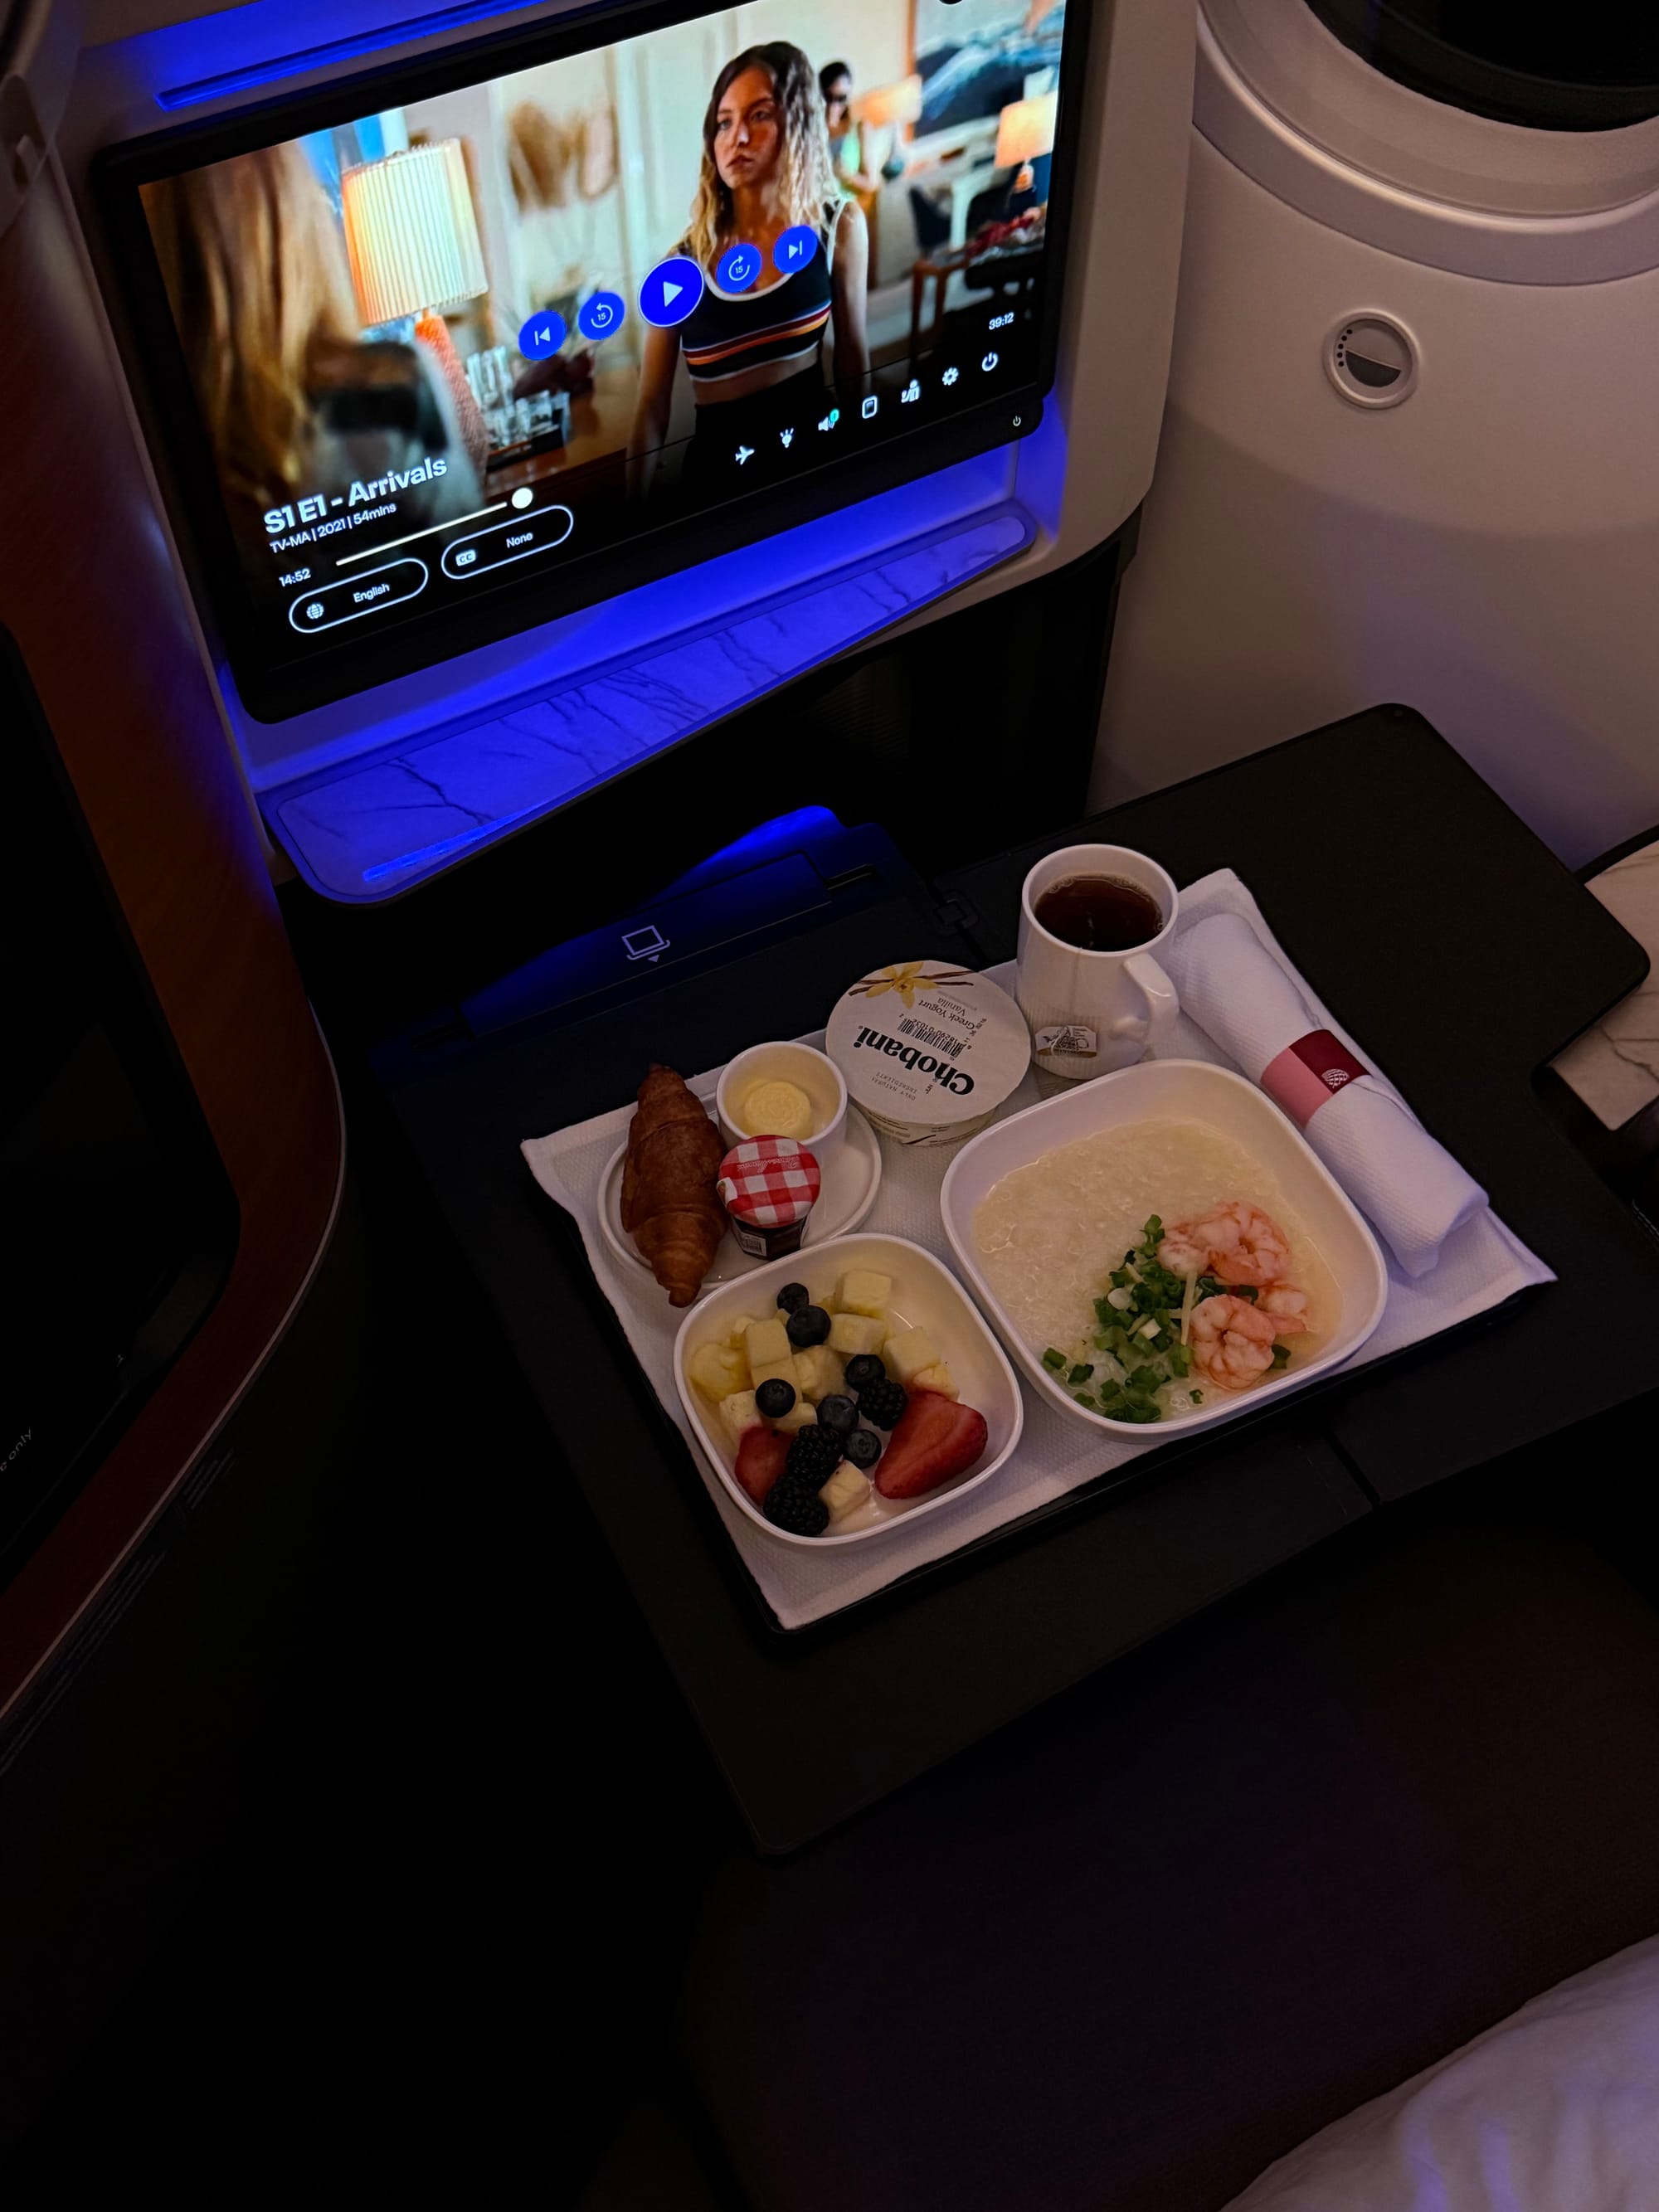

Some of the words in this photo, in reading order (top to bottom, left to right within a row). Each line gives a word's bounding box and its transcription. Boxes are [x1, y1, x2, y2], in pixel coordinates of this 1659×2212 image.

[735, 265, 744, 275] 15
[597, 312, 607, 322] 15
[988, 312, 1015, 330] 39:12
[263, 503, 295, 534] S1
[298, 493, 328, 524] E1
[330, 496, 344, 507] -
[347, 457, 447, 505] Arrivals
[270, 531, 311, 554] TV-MA
[317, 518, 346, 538] 2021
[353, 503, 397, 525] 54mins
[505, 531, 534, 548] None
[278, 567, 312, 587] 14:52
[353, 582, 391, 603] English
[917, 999, 949, 1018] Yogurt
[937, 997, 966, 1016] Vanilla
[948, 1009, 977, 1030] Greek
[853, 1027, 975, 1096] Chobani
[8, 1427, 32, 1460] only
